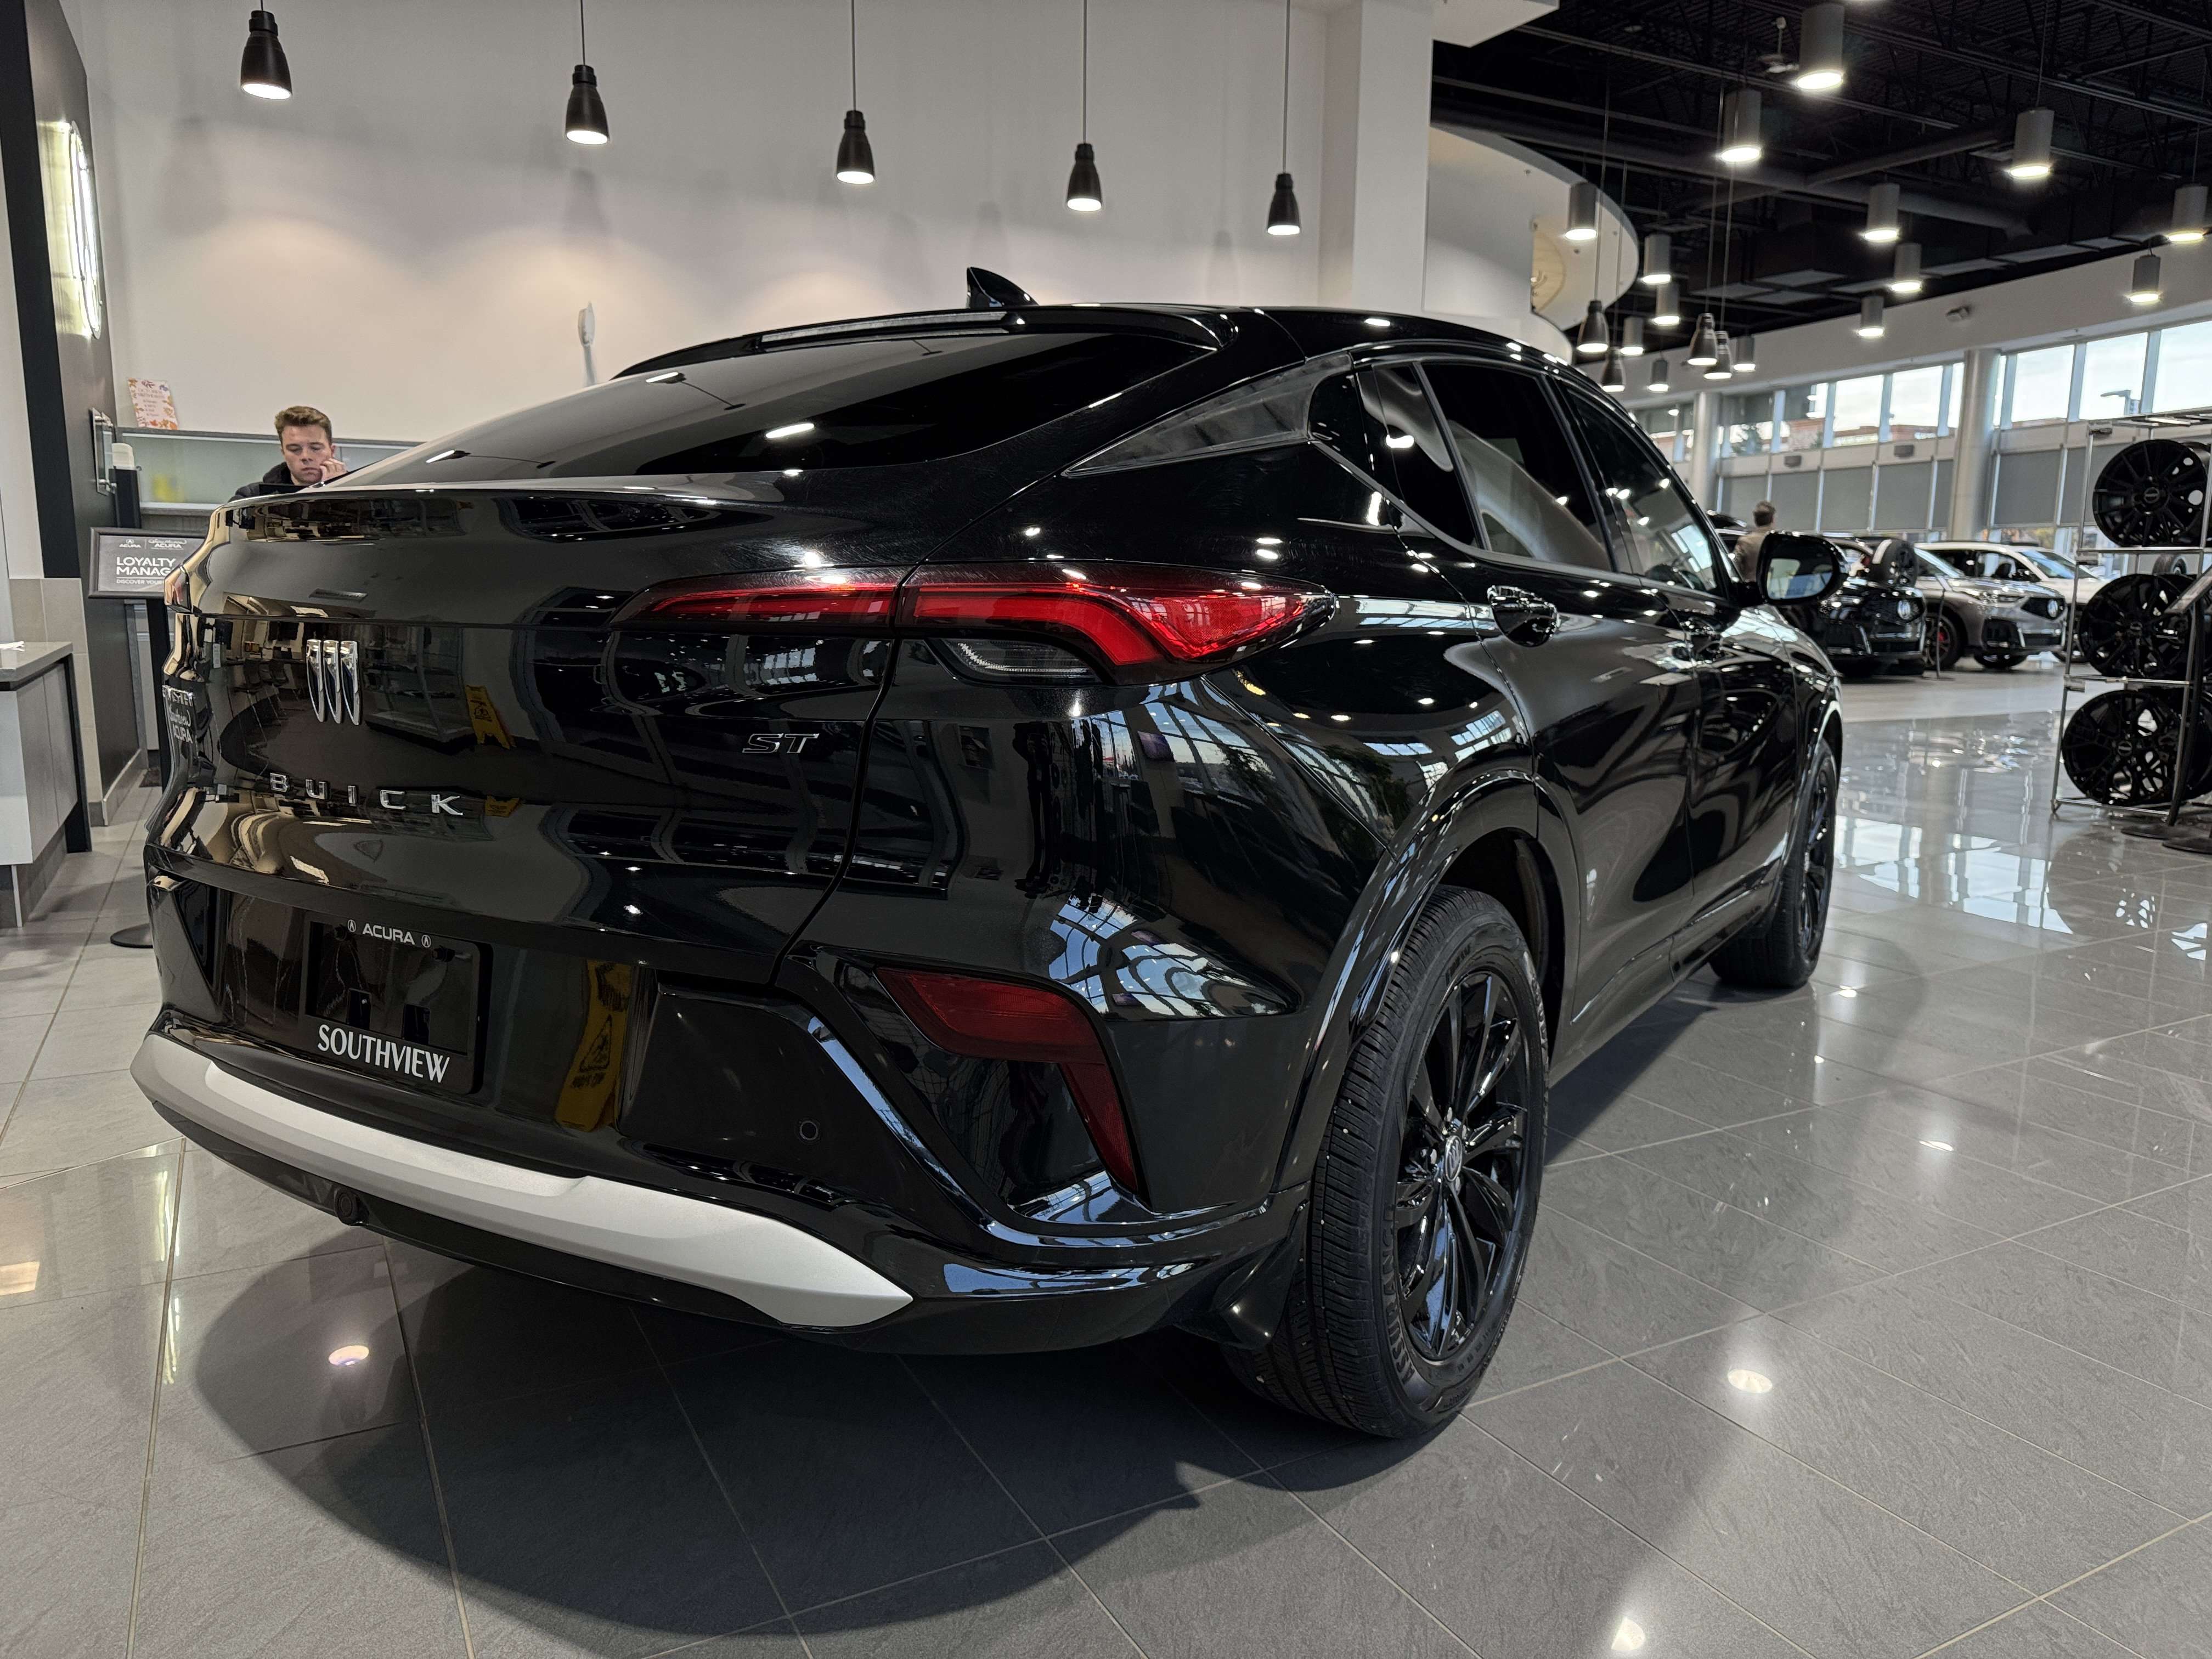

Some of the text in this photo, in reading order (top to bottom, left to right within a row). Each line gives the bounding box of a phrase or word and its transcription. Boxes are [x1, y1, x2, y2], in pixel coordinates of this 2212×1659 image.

[116, 556, 176, 567] LOYALTY
[116, 566, 173, 577] MANAG
[741, 733, 820, 753] ST
[269, 772, 464, 815] BUICK
[362, 923, 415, 945] ACURA
[317, 1024, 450, 1084] SOUTHVIEW
